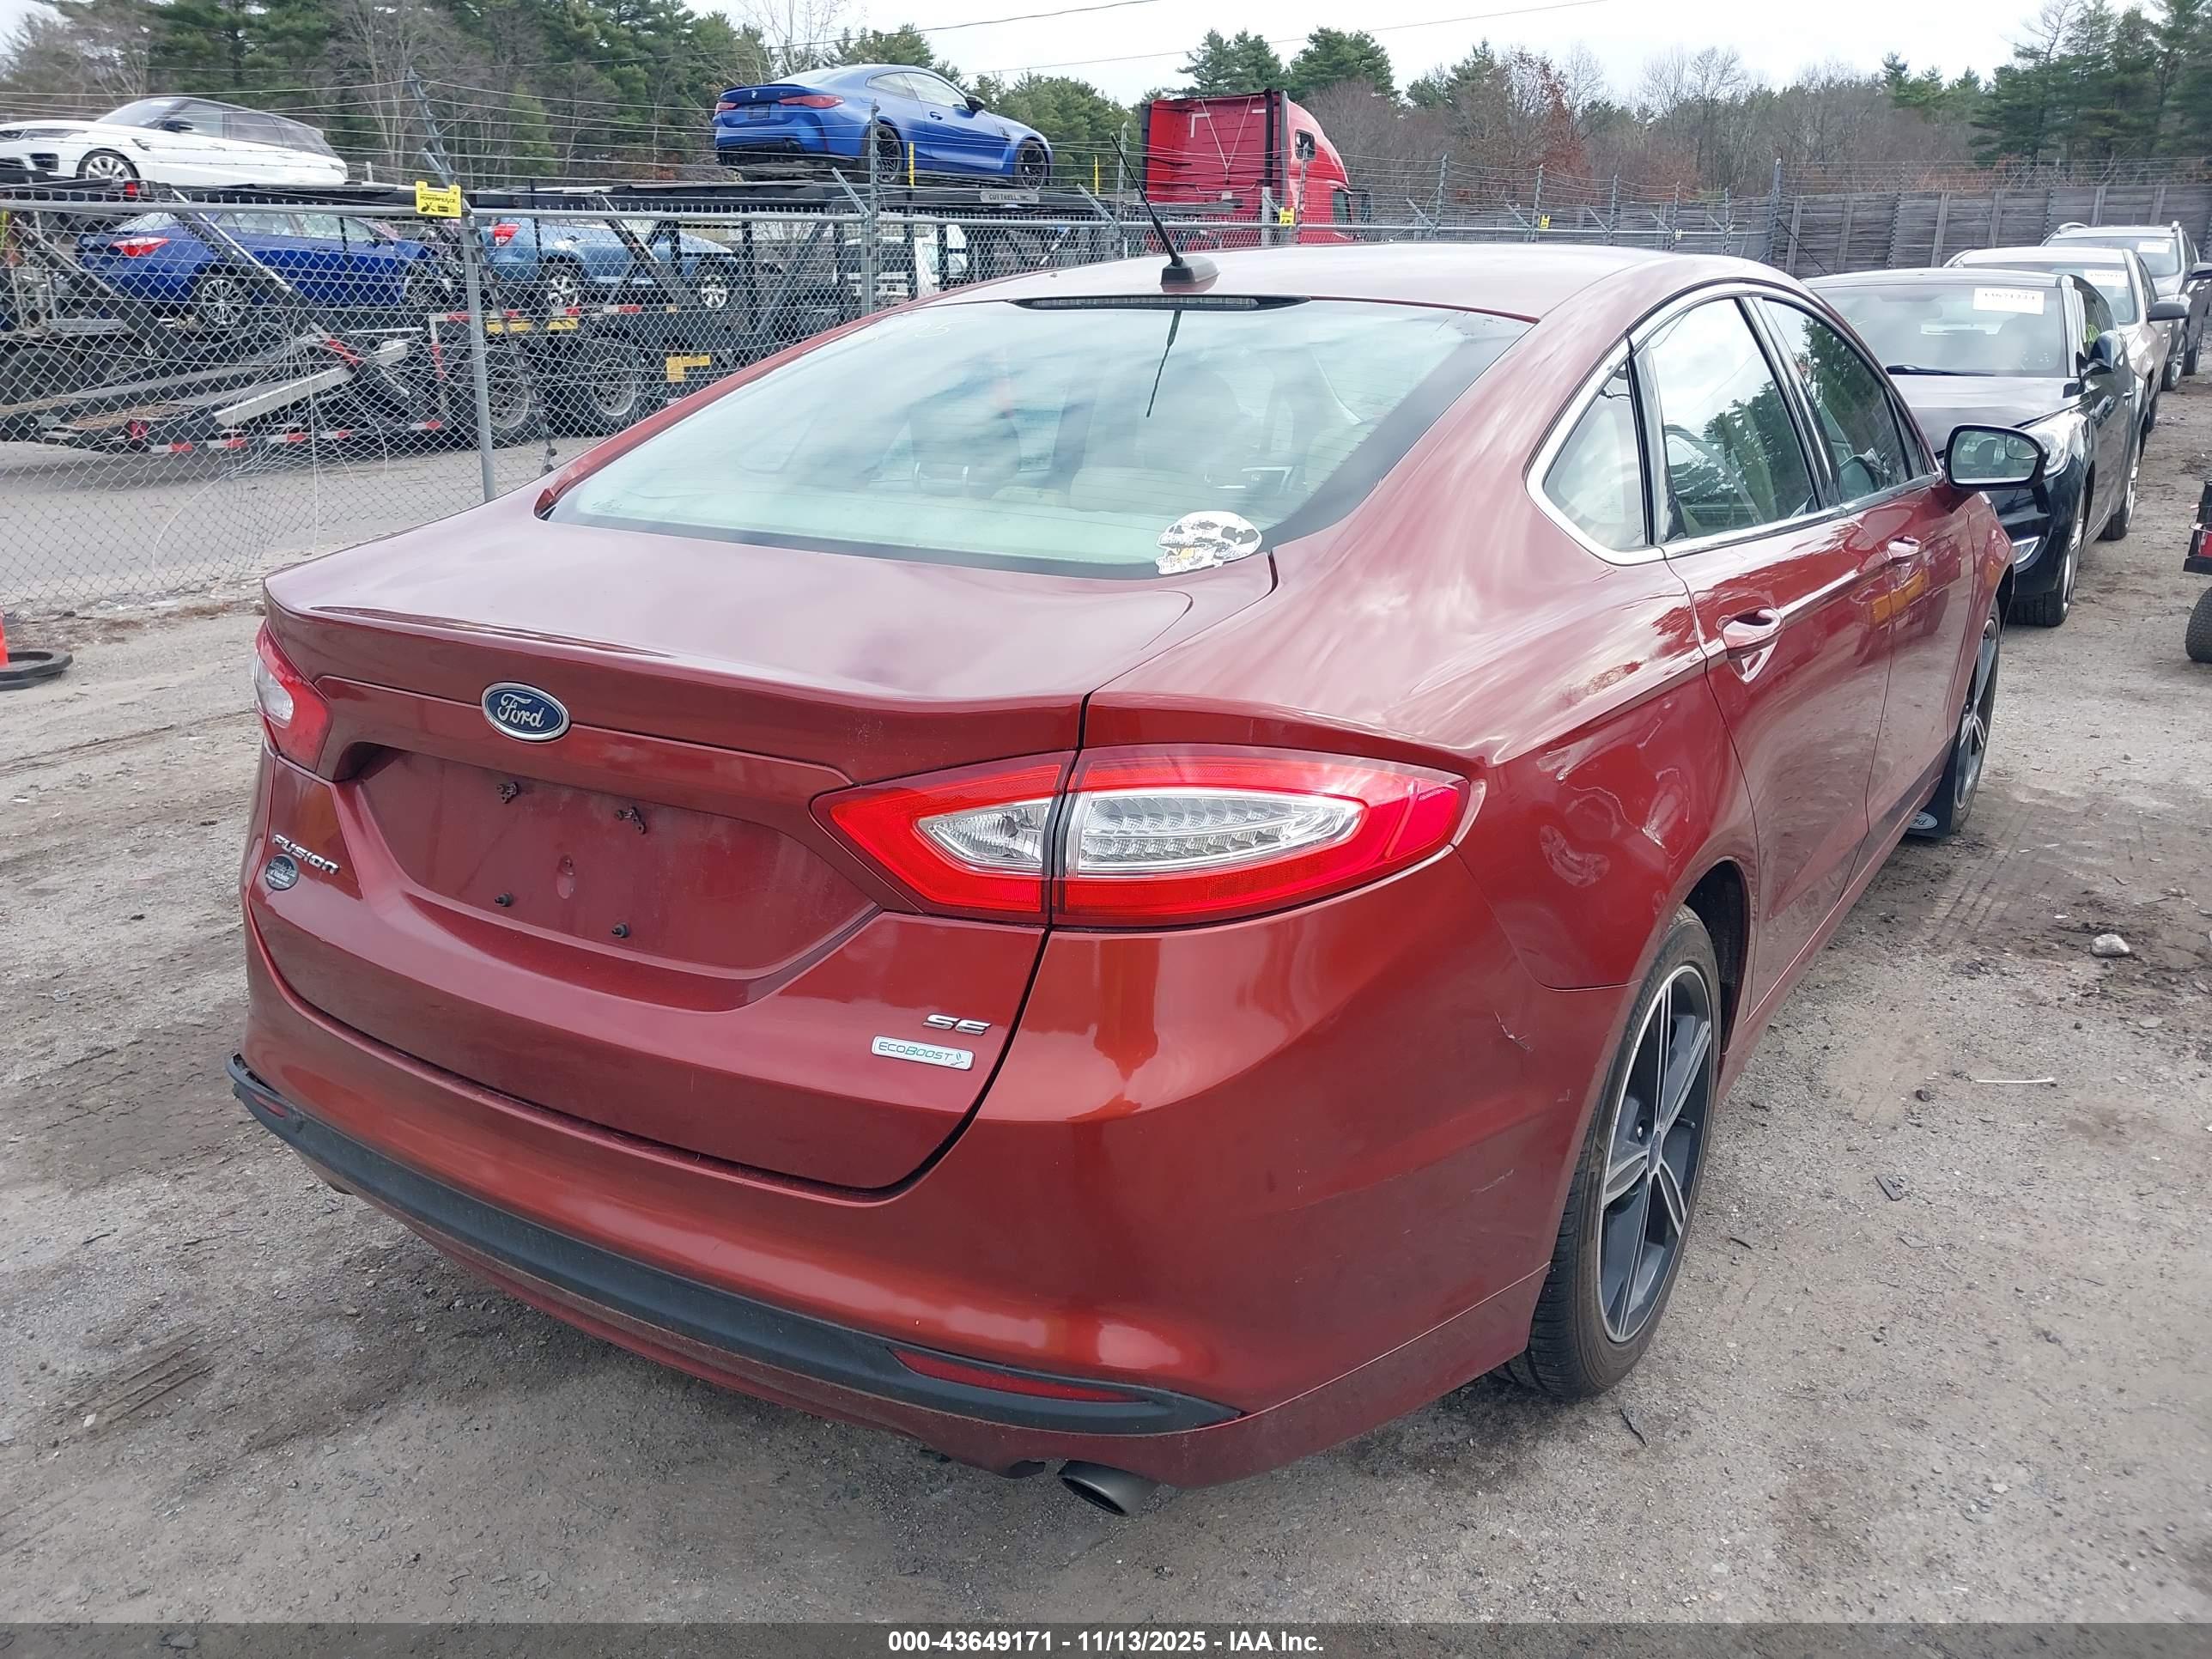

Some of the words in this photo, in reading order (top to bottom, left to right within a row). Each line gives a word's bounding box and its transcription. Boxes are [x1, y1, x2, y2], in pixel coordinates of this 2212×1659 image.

[496, 693, 546, 728] Ford
[271, 834, 341, 874] FUSION
[921, 1013, 992, 1036] SE
[878, 1041, 955, 1061] ECOBOOST
